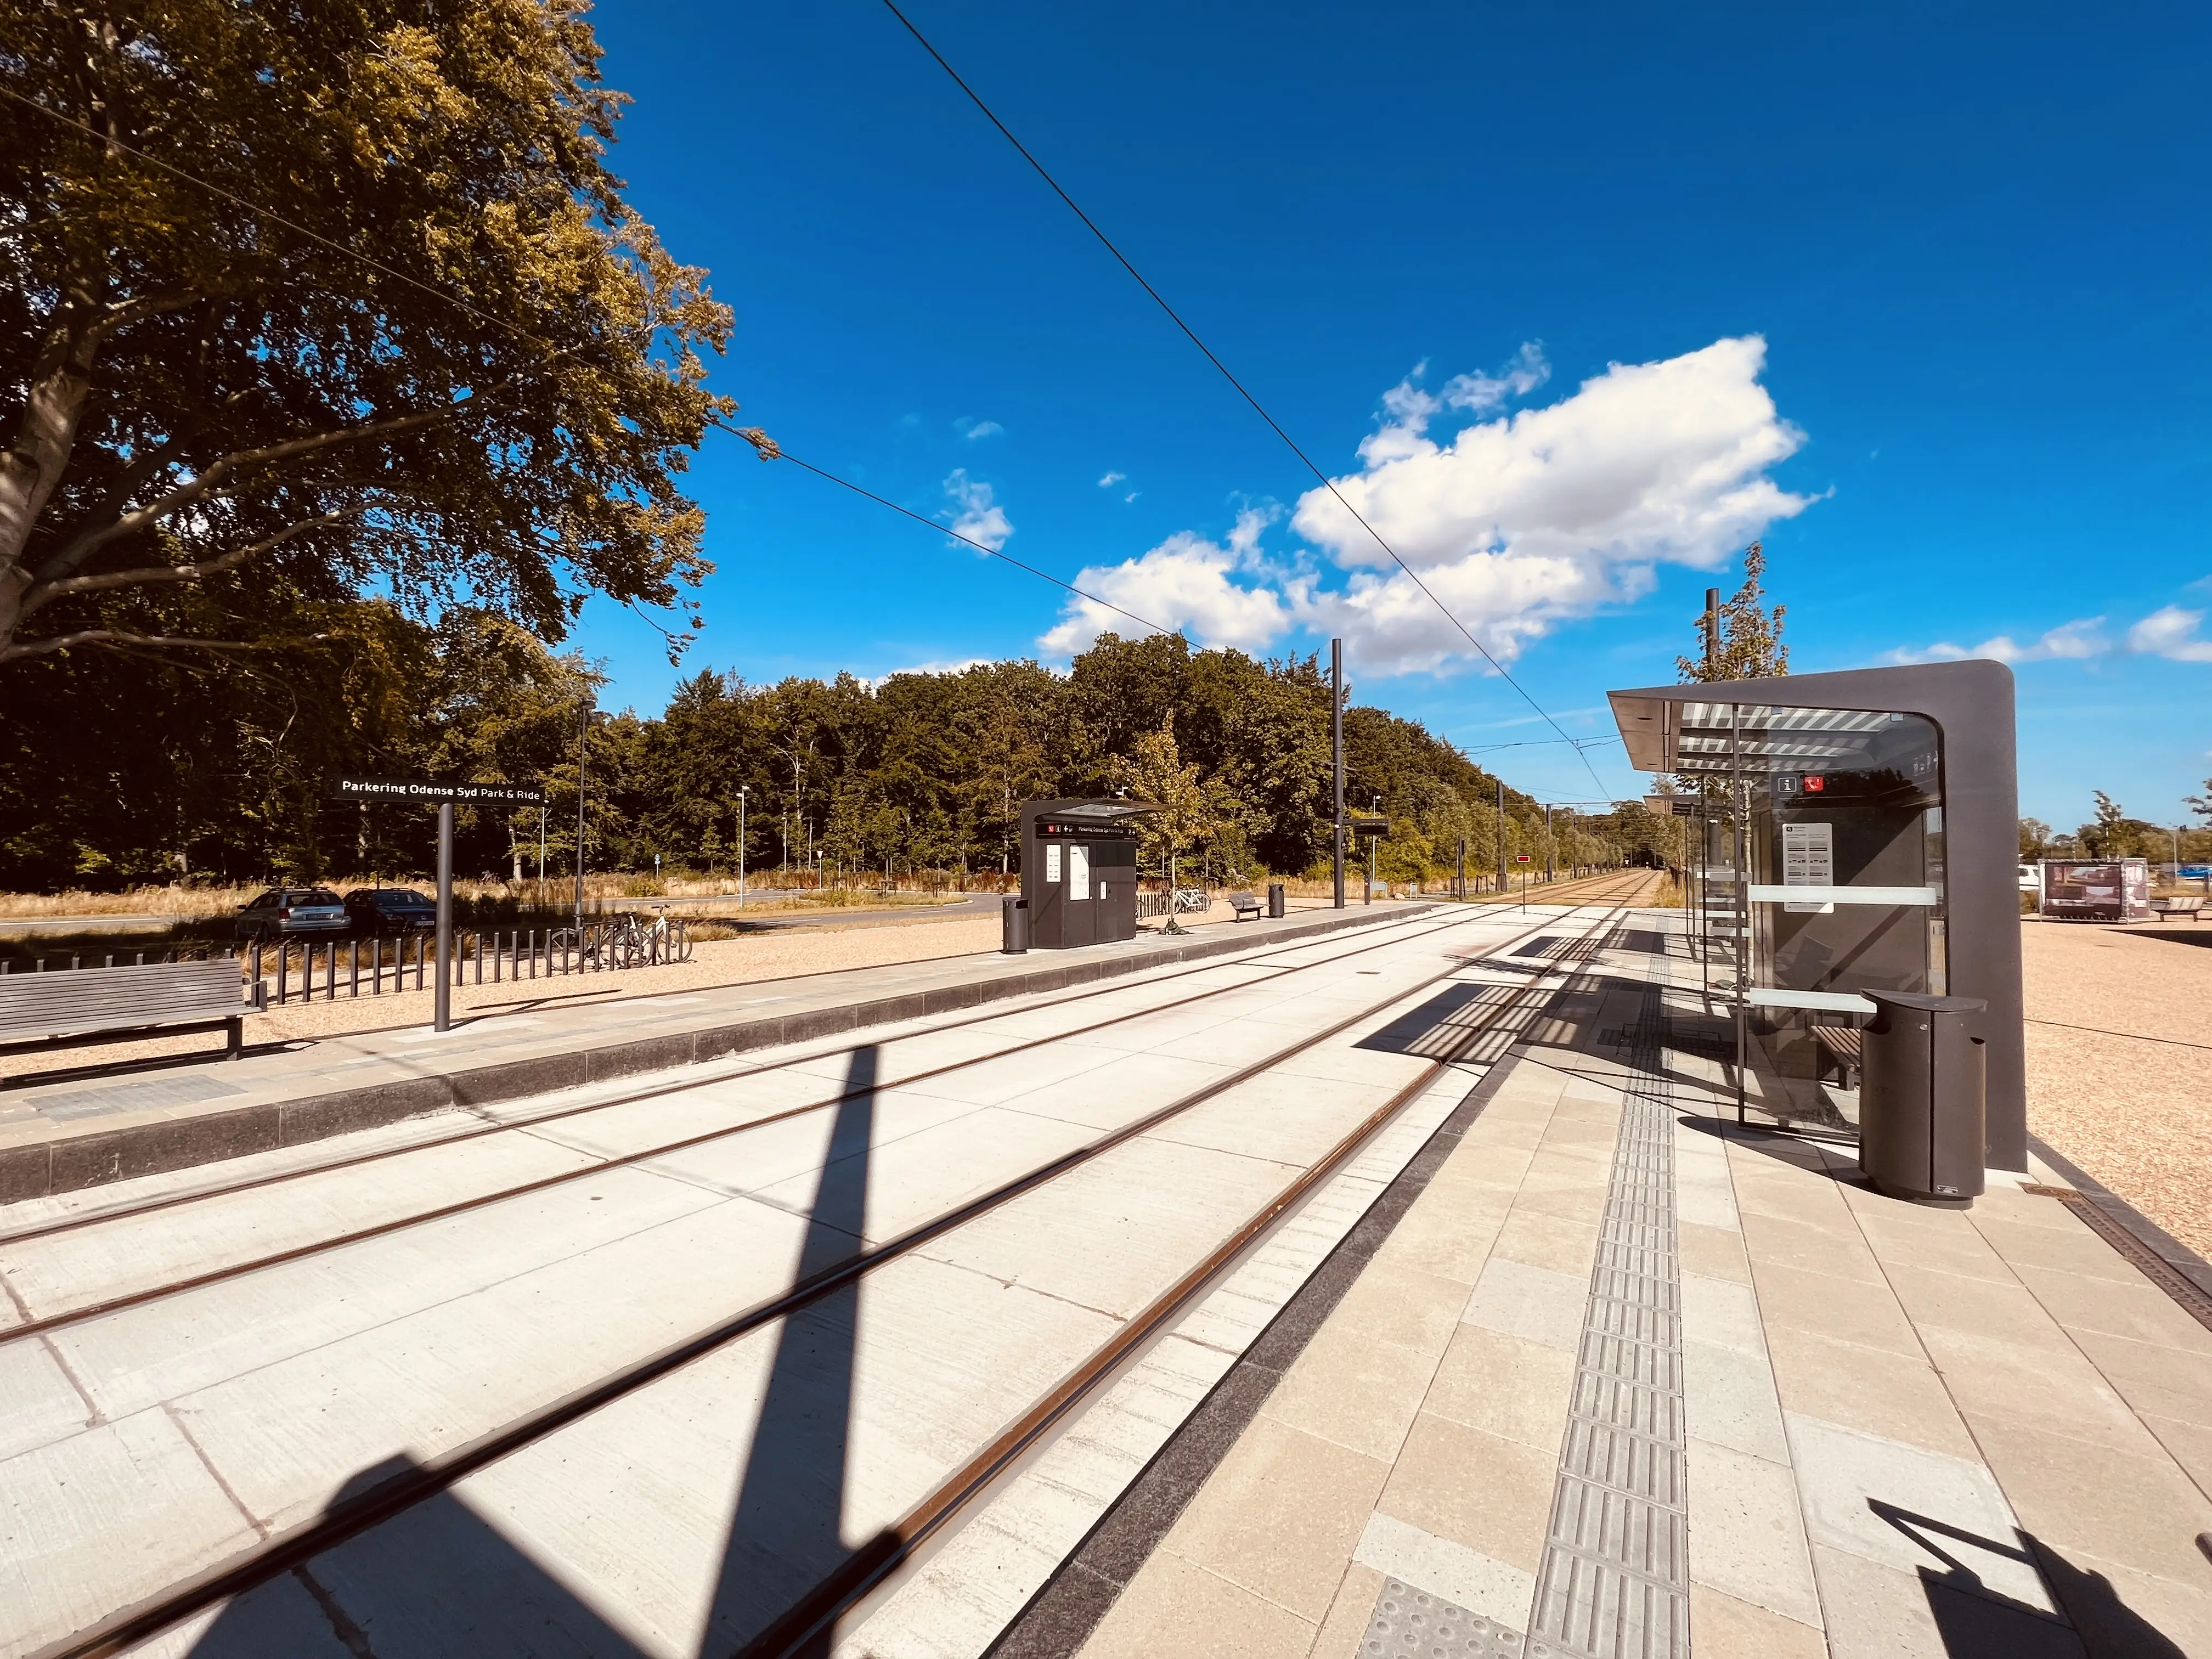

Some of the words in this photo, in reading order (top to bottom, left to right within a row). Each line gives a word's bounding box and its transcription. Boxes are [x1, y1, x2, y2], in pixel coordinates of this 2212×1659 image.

[342, 781, 406, 795] Parkering
[409, 785, 454, 795] Odense
[457, 787, 477, 798] Syd
[481, 788, 504, 798] Park
[506, 790, 514, 798] &
[517, 791, 540, 800] Ride
